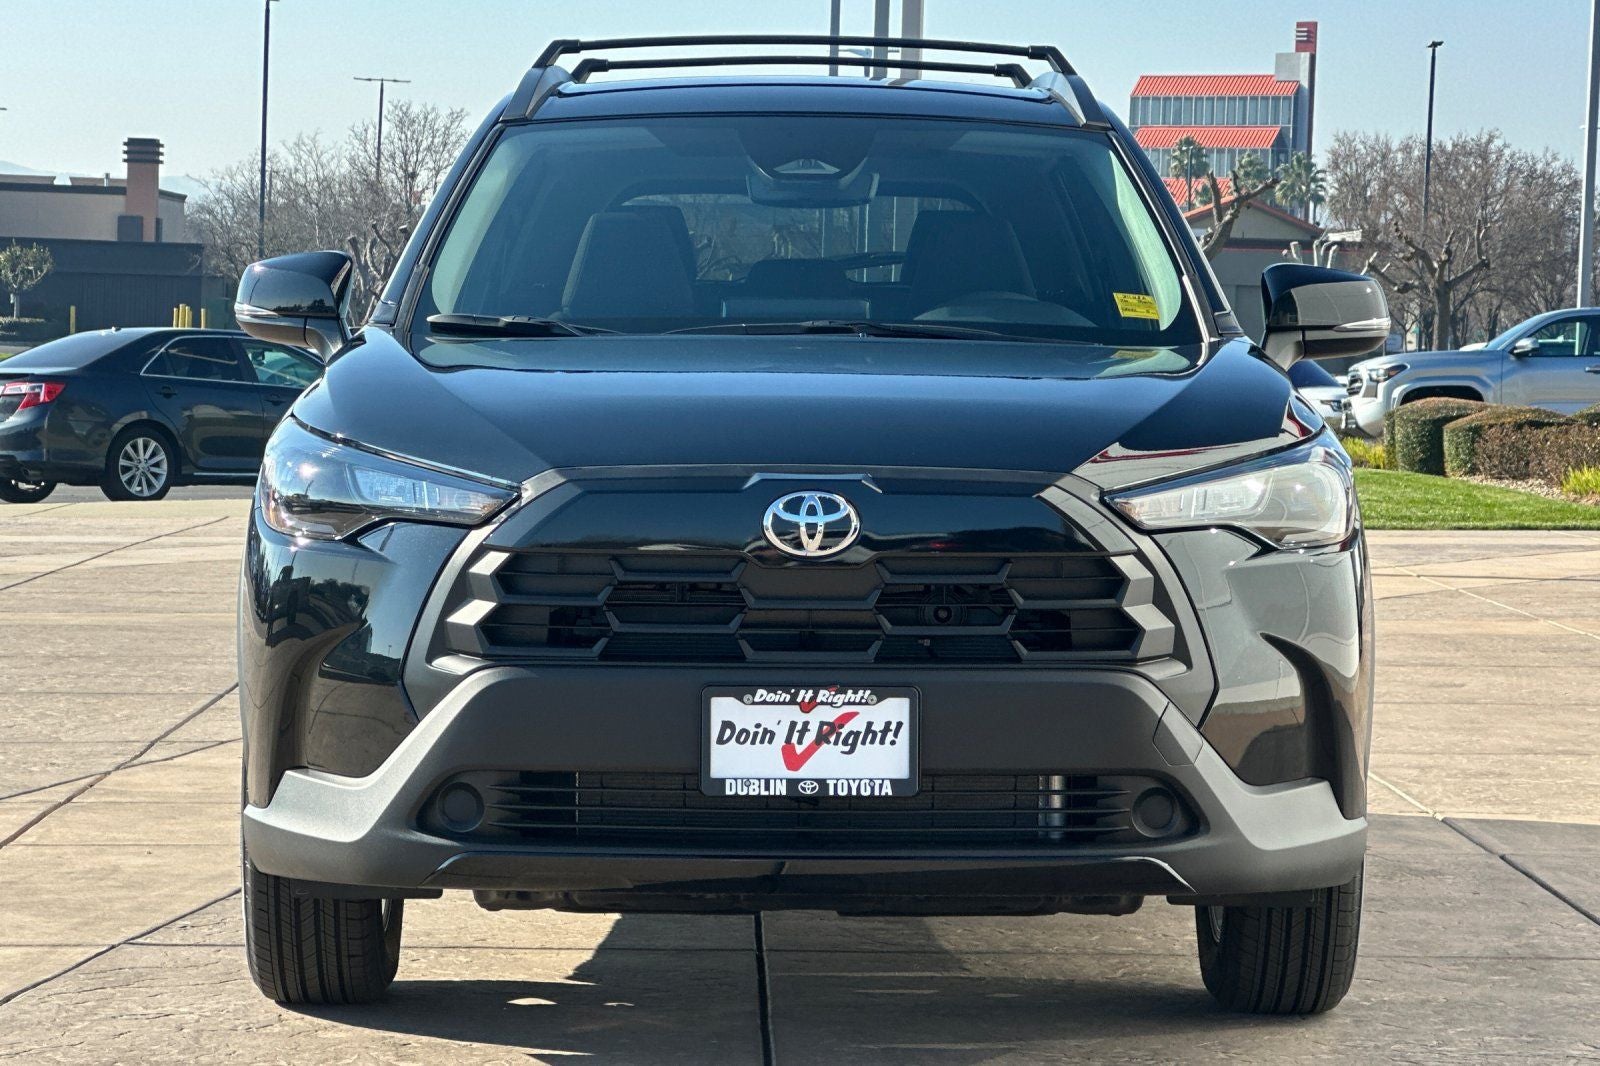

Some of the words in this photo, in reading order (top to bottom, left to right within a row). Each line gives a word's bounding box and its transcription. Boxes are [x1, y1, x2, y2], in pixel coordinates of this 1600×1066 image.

[753, 689, 795, 703] Doin'
[796, 689, 815, 703] It
[816, 689, 871, 707] Right!
[715, 719, 782, 746] Doin'
[784, 720, 811, 746] It
[814, 720, 904, 755] Right!
[725, 779, 787, 796] DUBLIN
[826, 779, 893, 796] TOYOTA
